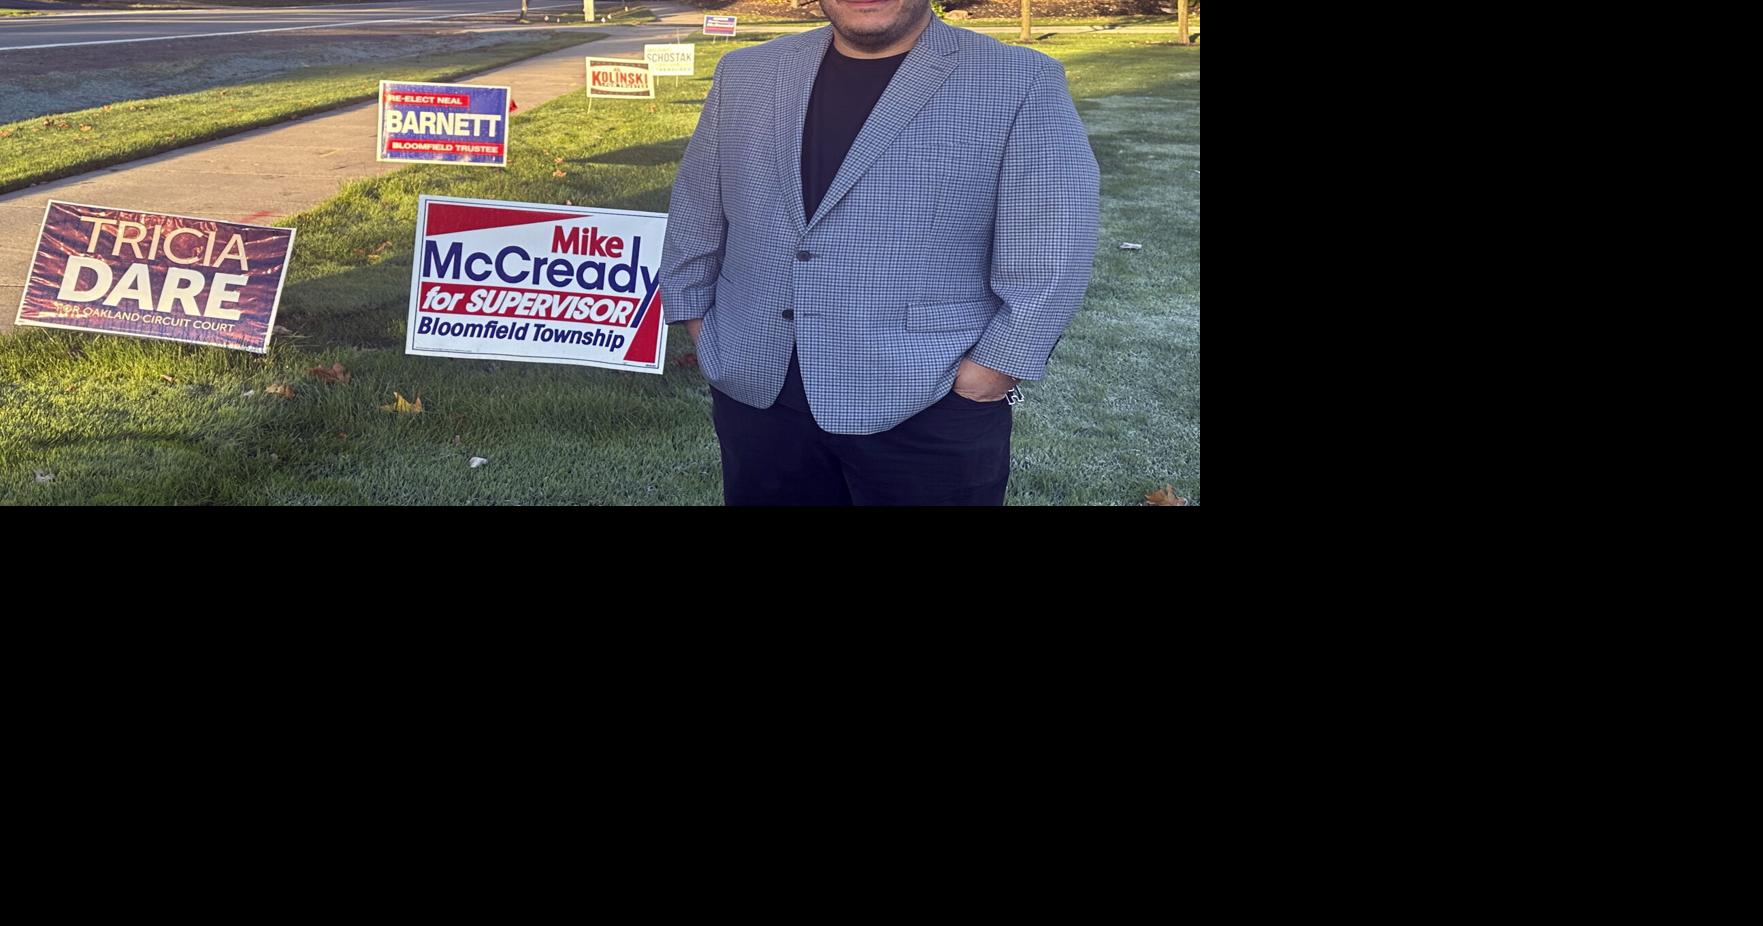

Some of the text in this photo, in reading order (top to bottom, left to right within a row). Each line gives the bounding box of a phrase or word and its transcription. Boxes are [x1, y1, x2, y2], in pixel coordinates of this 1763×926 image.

[646, 52, 692, 62] SCHOSTAK
[591, 70, 648, 86] KOLINSKI
[437, 96, 463, 105] NEAL
[386, 110, 501, 137] BARNETT
[392, 142, 499, 153] BLOOMFIELD TRUSTEE
[80, 215, 249, 271] TRICIA
[551, 225, 624, 258] Mike
[57, 255, 250, 321] DARE
[422, 236, 660, 328] McCready
[83, 306, 141, 322] OAKLAND
[142, 314, 191, 328] CIRCUIT
[193, 320, 236, 333] COURT
[421, 286, 634, 324] for SUPERVISOR
[417, 316, 625, 352] Bloomfield Township
